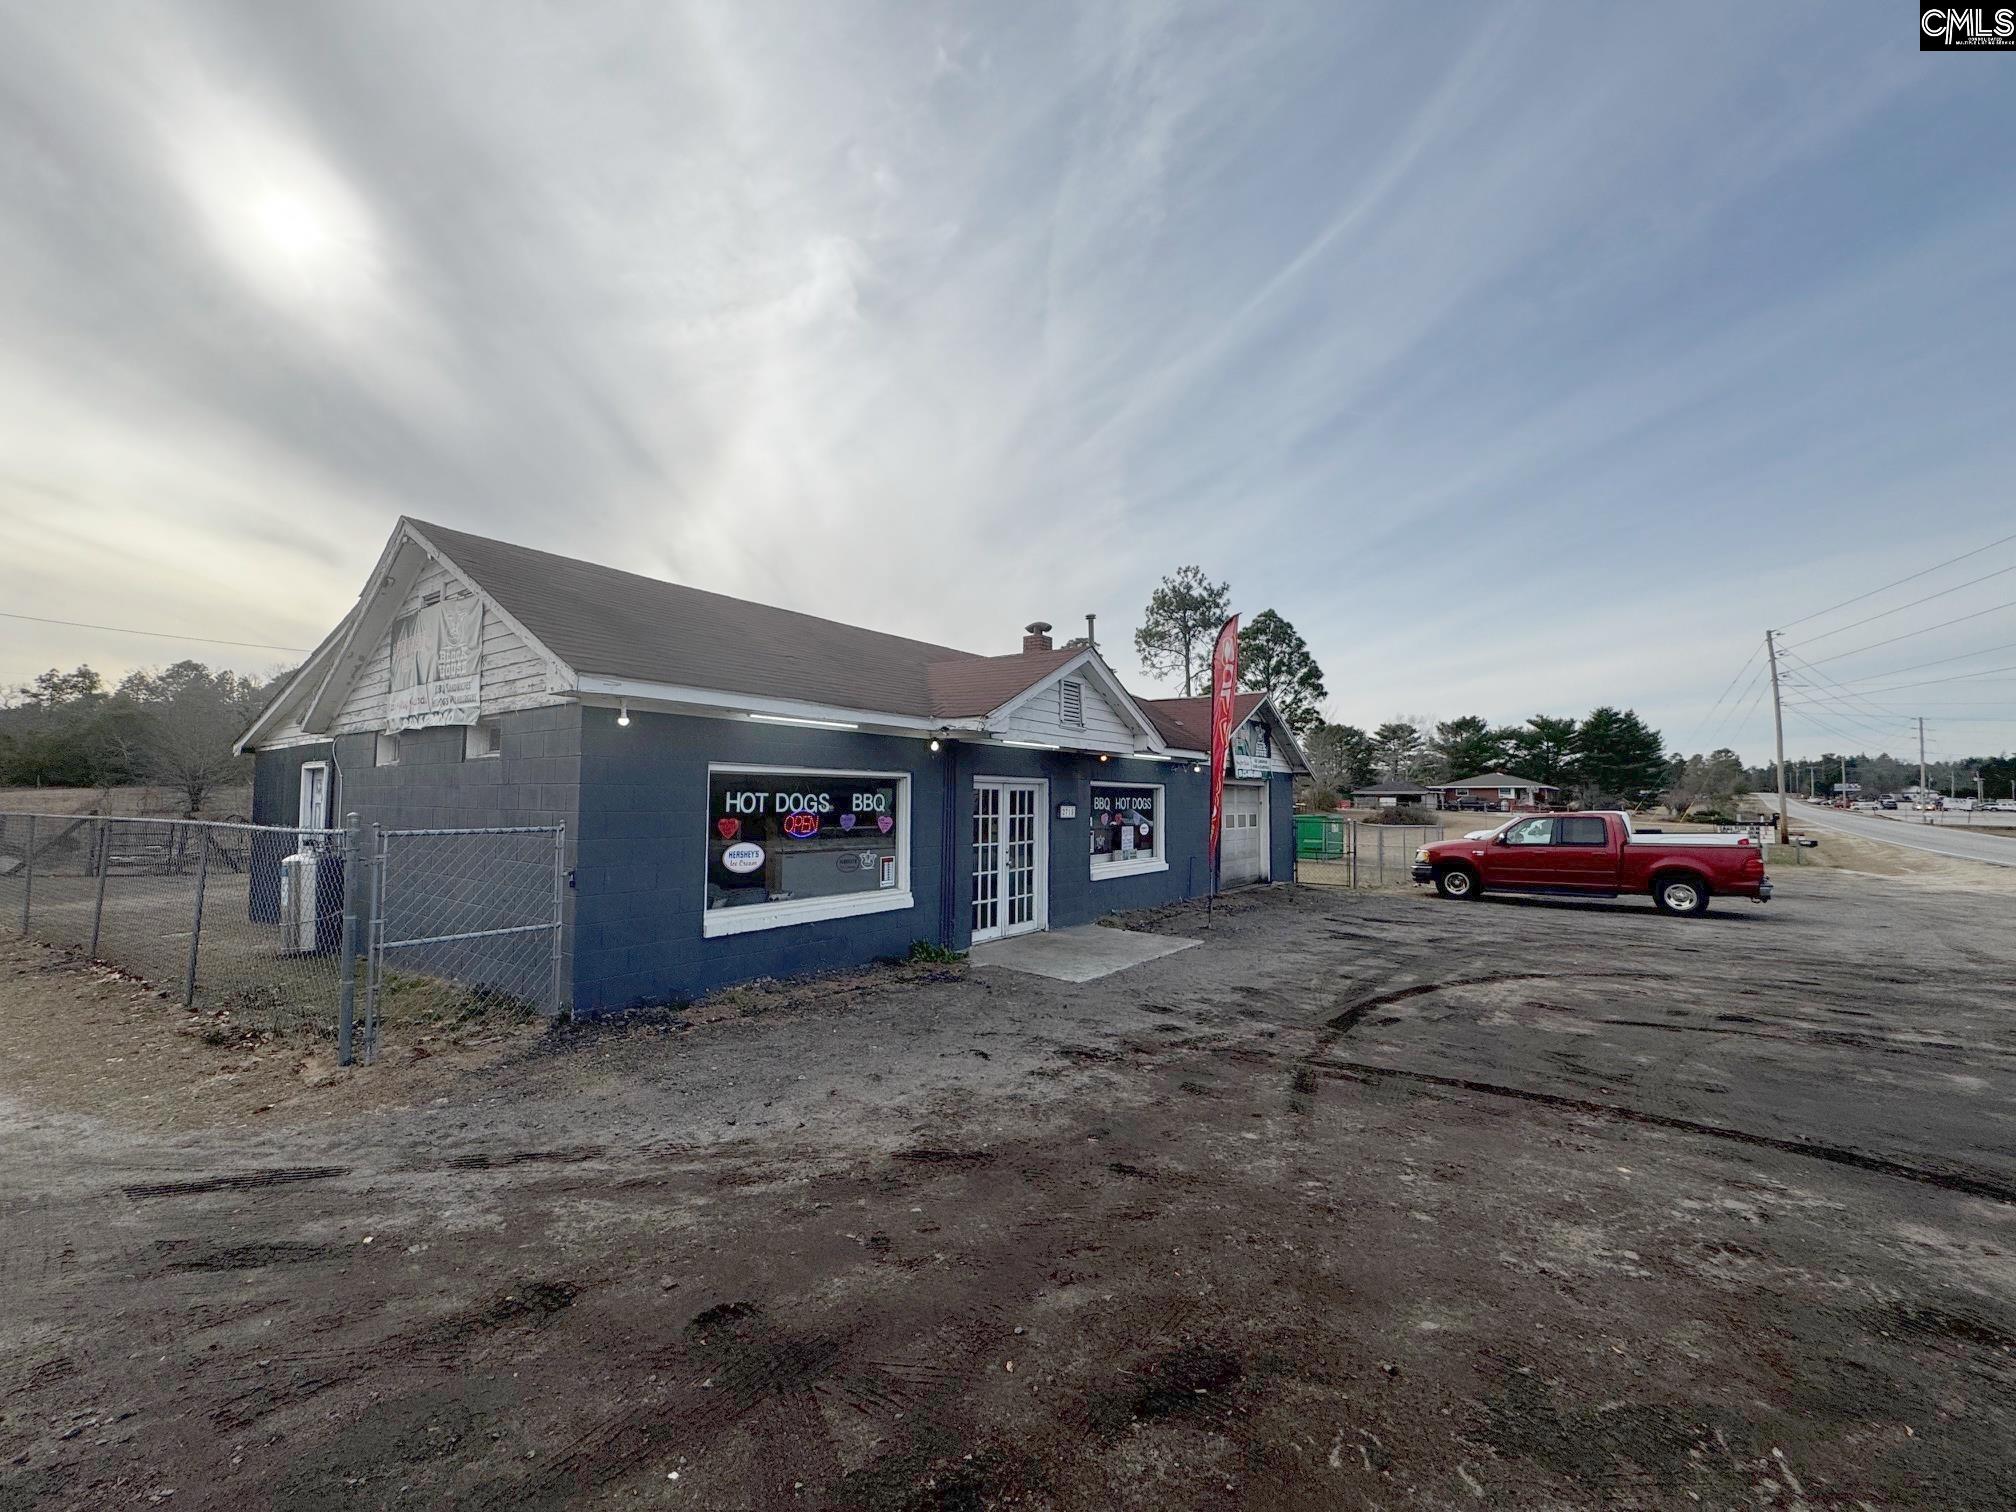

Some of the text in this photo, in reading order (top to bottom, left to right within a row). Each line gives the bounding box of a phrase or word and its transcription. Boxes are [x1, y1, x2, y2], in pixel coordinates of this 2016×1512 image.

[725, 792, 886, 813] HOT DOGS BBQ
[1094, 797, 1152, 811] BBQ HOT DOGS
[784, 814, 820, 834] OPEN
[728, 850, 760, 859] HERSHEY'S
[739, 859, 758, 867] Cream
